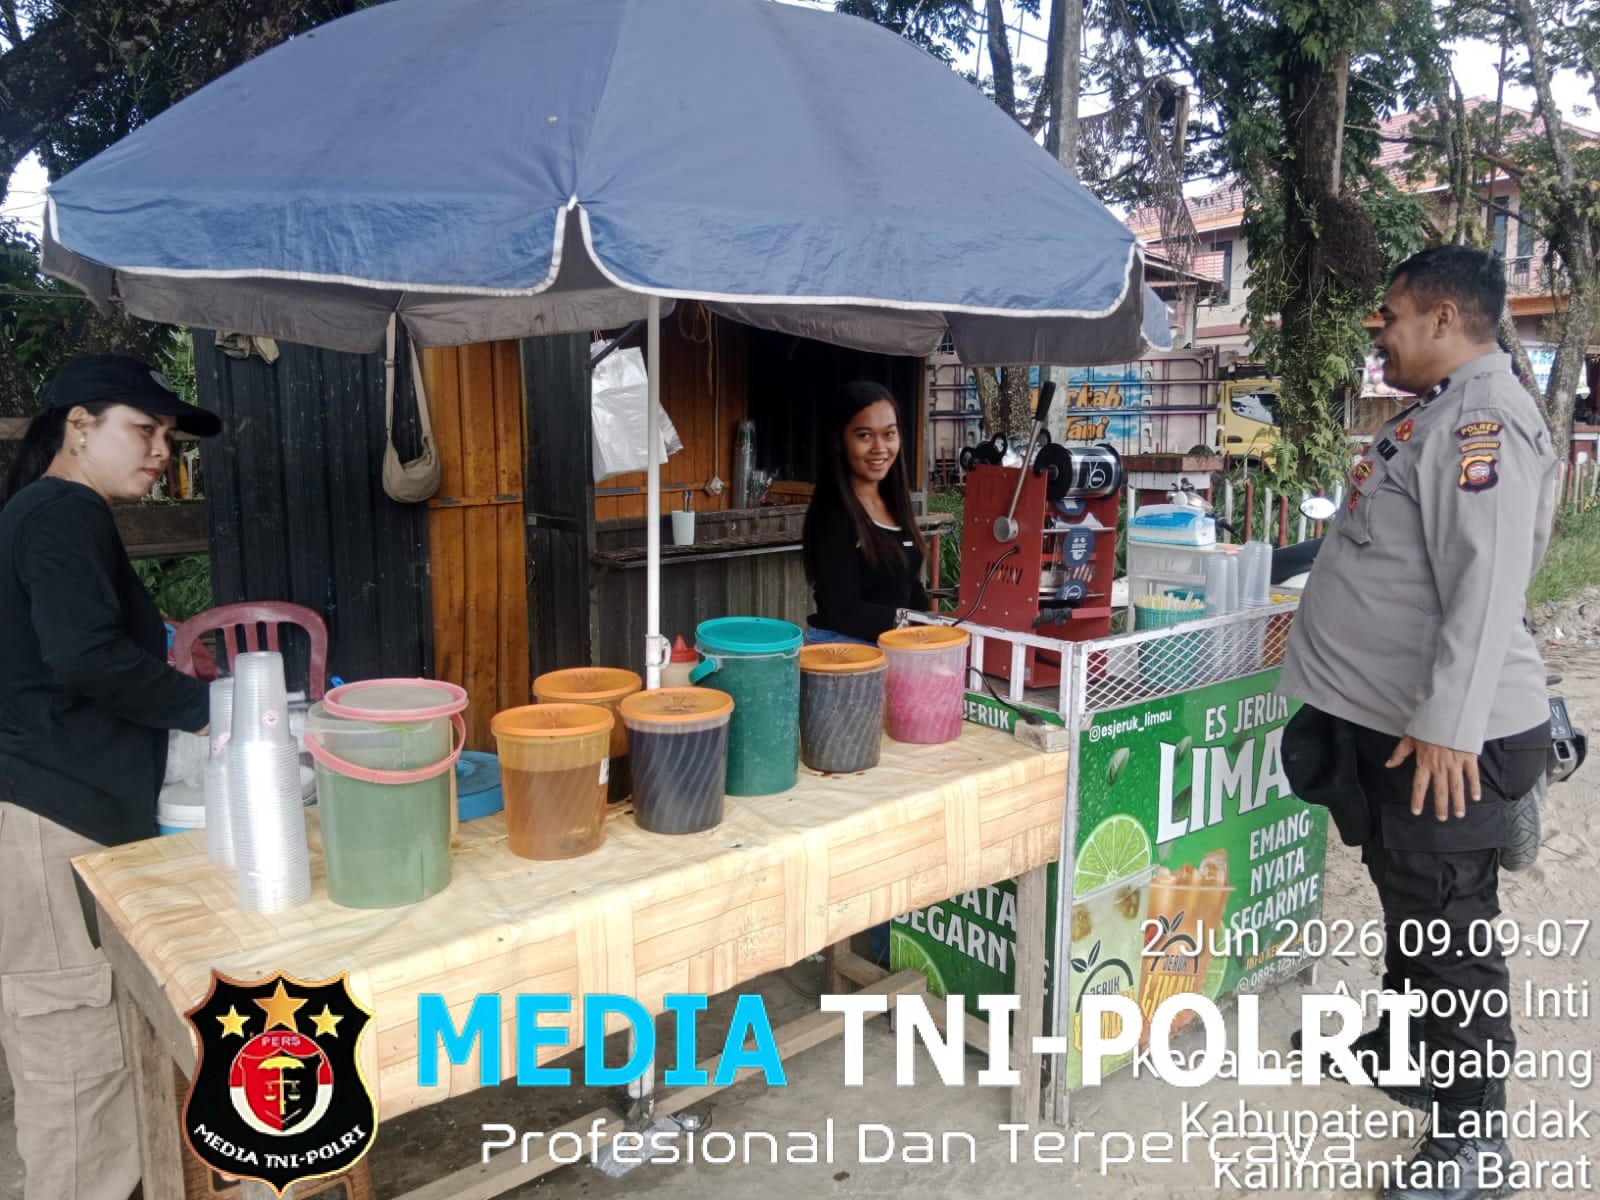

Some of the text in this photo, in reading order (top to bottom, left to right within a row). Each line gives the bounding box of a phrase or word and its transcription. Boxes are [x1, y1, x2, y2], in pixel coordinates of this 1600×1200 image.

[1205, 705, 1227, 742] ES
[1156, 726, 1293, 845] LIMA
[1249, 809, 1310, 861] EMANG
[1249, 847, 1305, 897] NYATA
[950, 886, 1017, 932] ATA
[1230, 873, 1319, 939] SEGARNYE
[893, 905, 1034, 977] EGARN
